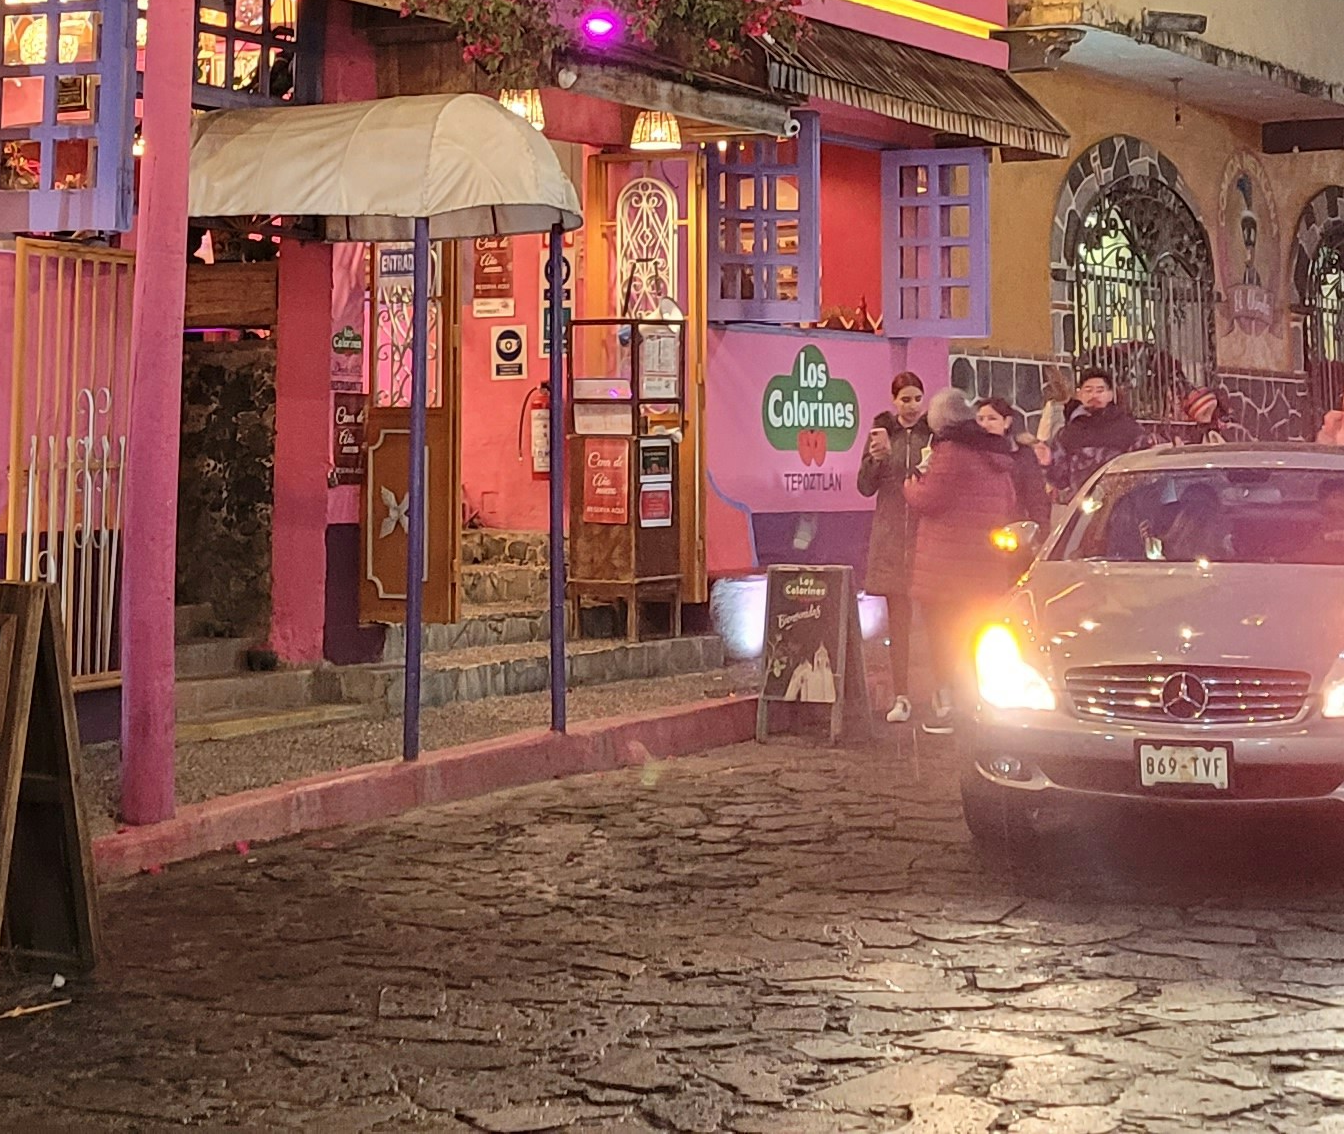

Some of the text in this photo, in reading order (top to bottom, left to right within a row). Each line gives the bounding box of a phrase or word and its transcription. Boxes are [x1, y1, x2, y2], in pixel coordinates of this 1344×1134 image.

[381, 254, 415, 272] ENTRAD
[799, 351, 827, 388] Los
[767, 389, 855, 428] Colorines
[784, 469, 842, 492] TEPOZTLÁN
[785, 585, 826, 596] Colorines
[799, 577, 814, 586] Los
